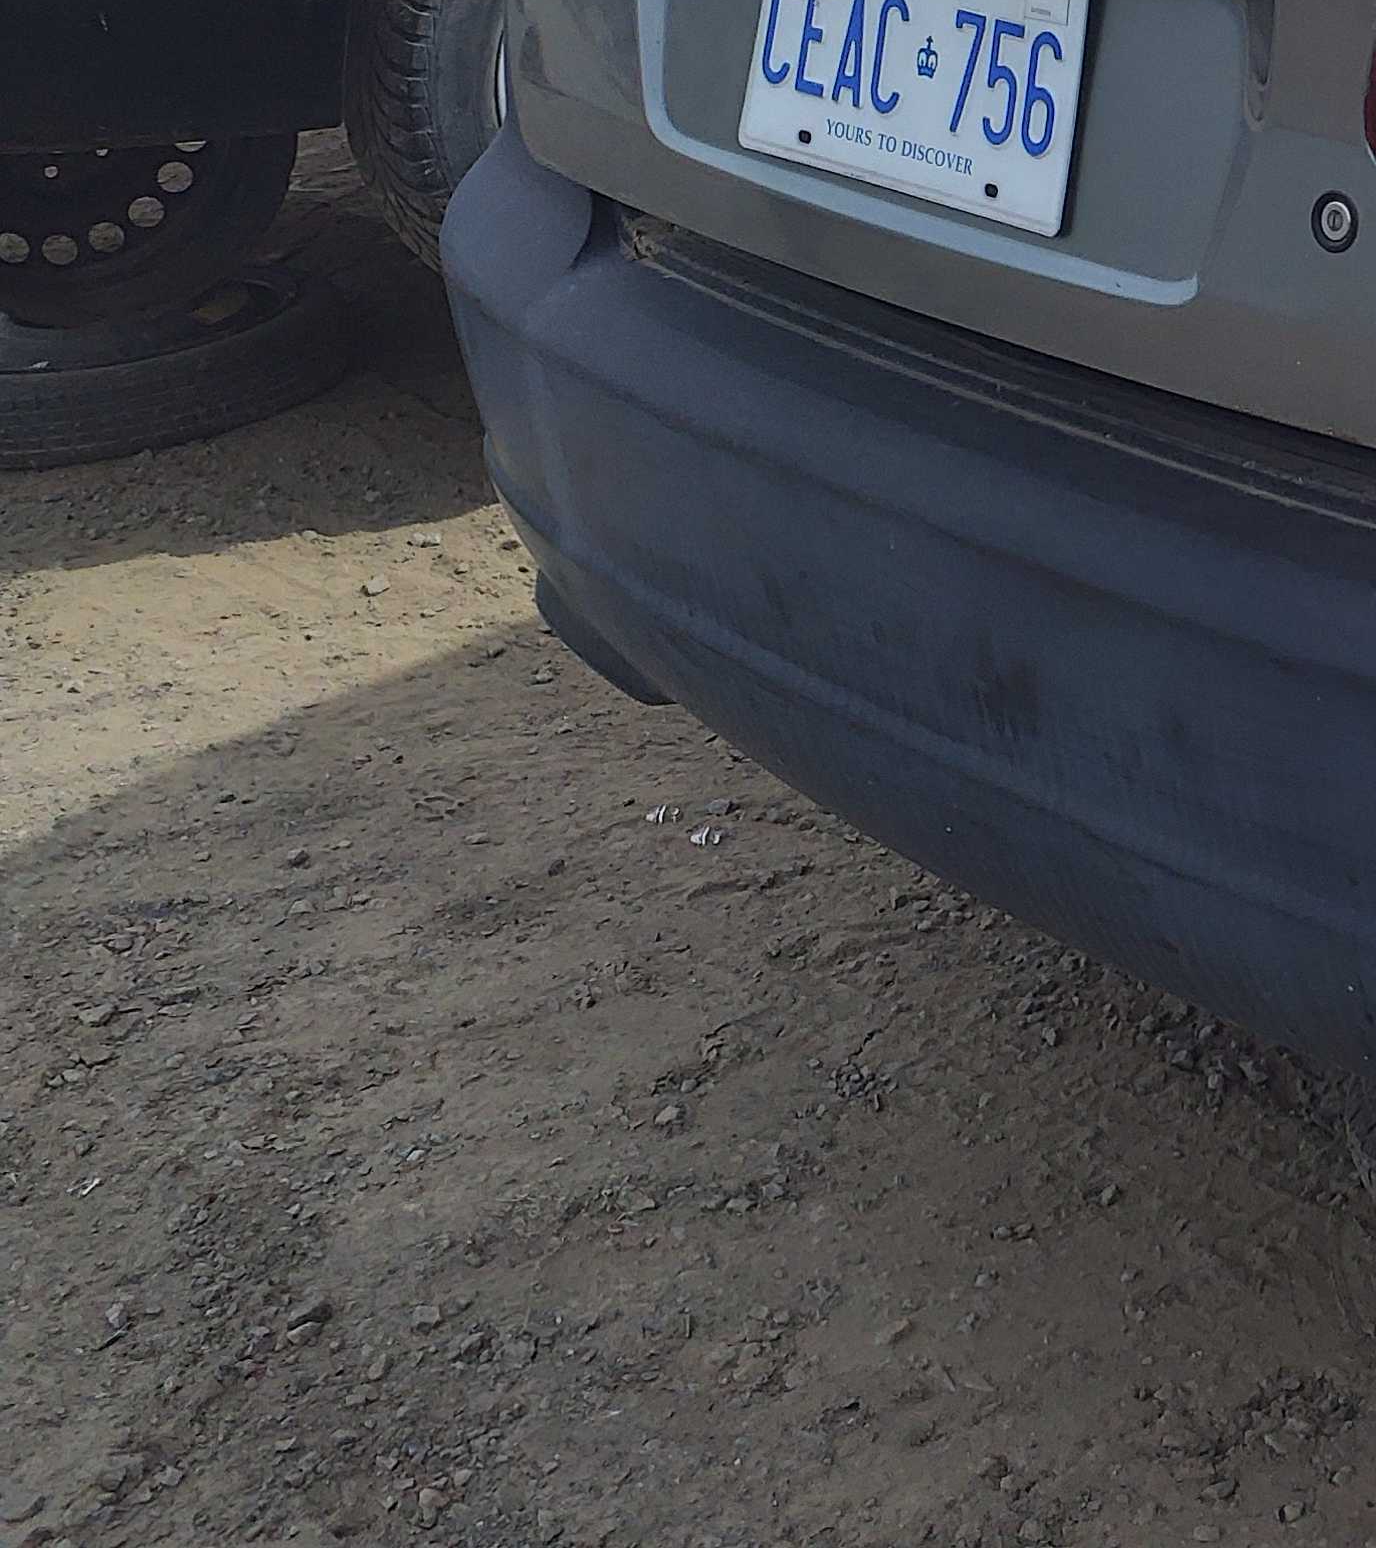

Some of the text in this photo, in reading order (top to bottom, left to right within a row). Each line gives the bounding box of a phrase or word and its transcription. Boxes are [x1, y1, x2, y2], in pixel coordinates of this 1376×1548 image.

[949, 8, 1063, 158] 756
[826, 118, 974, 177] YOURS TO DISCOVER
